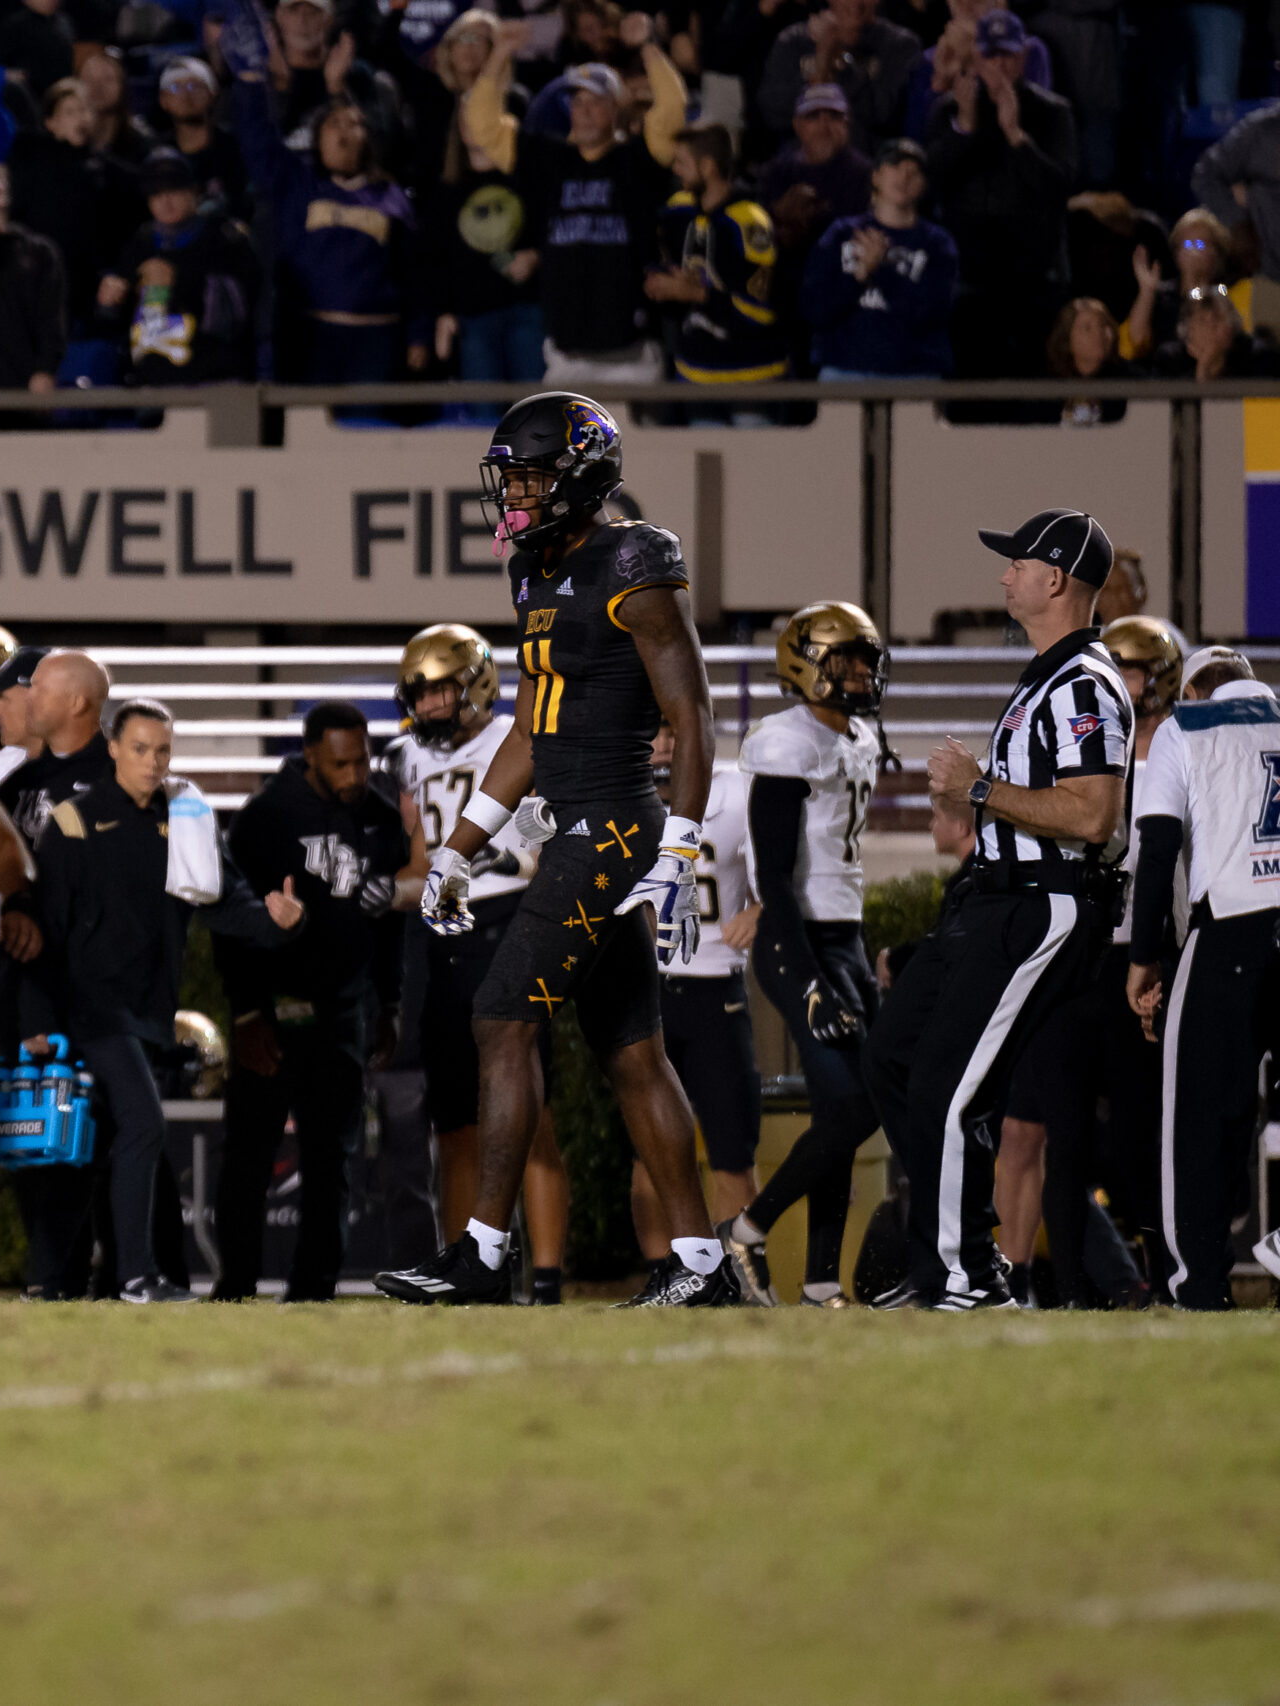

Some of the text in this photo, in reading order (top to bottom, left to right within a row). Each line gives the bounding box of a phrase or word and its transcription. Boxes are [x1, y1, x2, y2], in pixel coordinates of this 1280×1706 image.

[524, 608, 558, 635] ECU
[522, 639, 565, 734] 11
[1076, 722, 1094, 733] CFO
